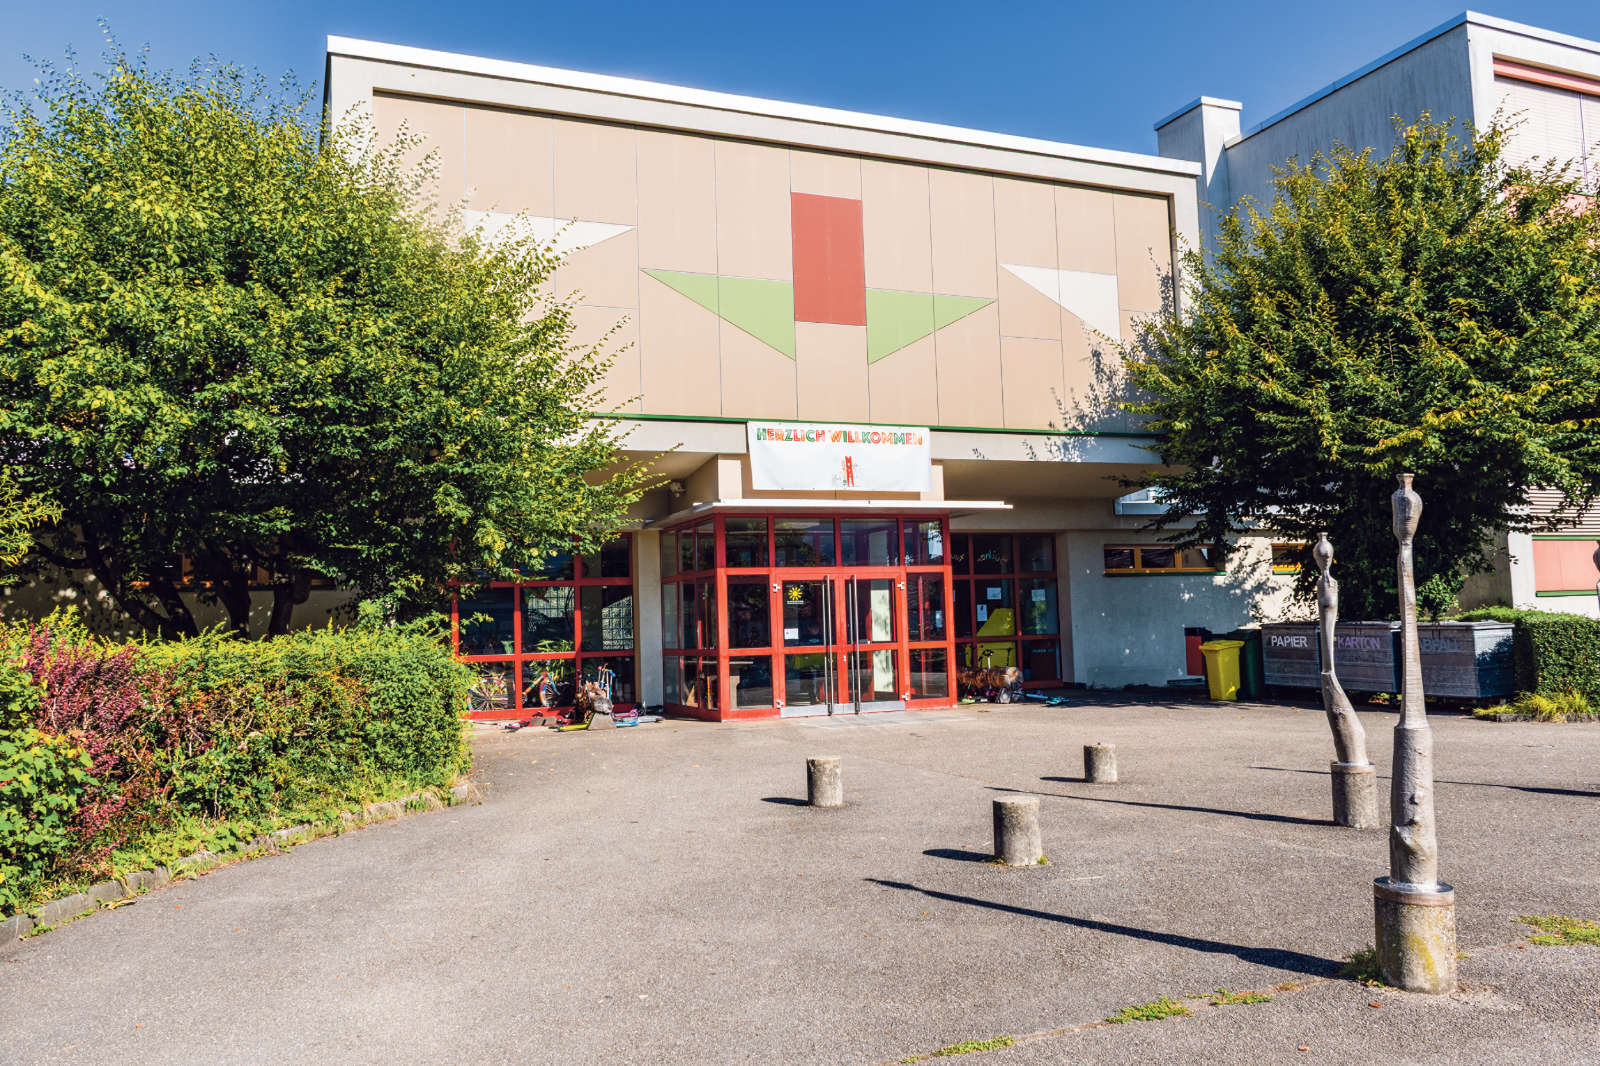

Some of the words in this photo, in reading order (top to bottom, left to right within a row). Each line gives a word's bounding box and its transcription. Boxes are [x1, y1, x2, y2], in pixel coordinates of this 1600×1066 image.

[757, 428, 825, 442] HERZLICH
[828, 430, 922, 445] WILLKOMMEN
[1271, 635, 1308, 648] PAPIER
[1337, 637, 1380, 649] KARTON
